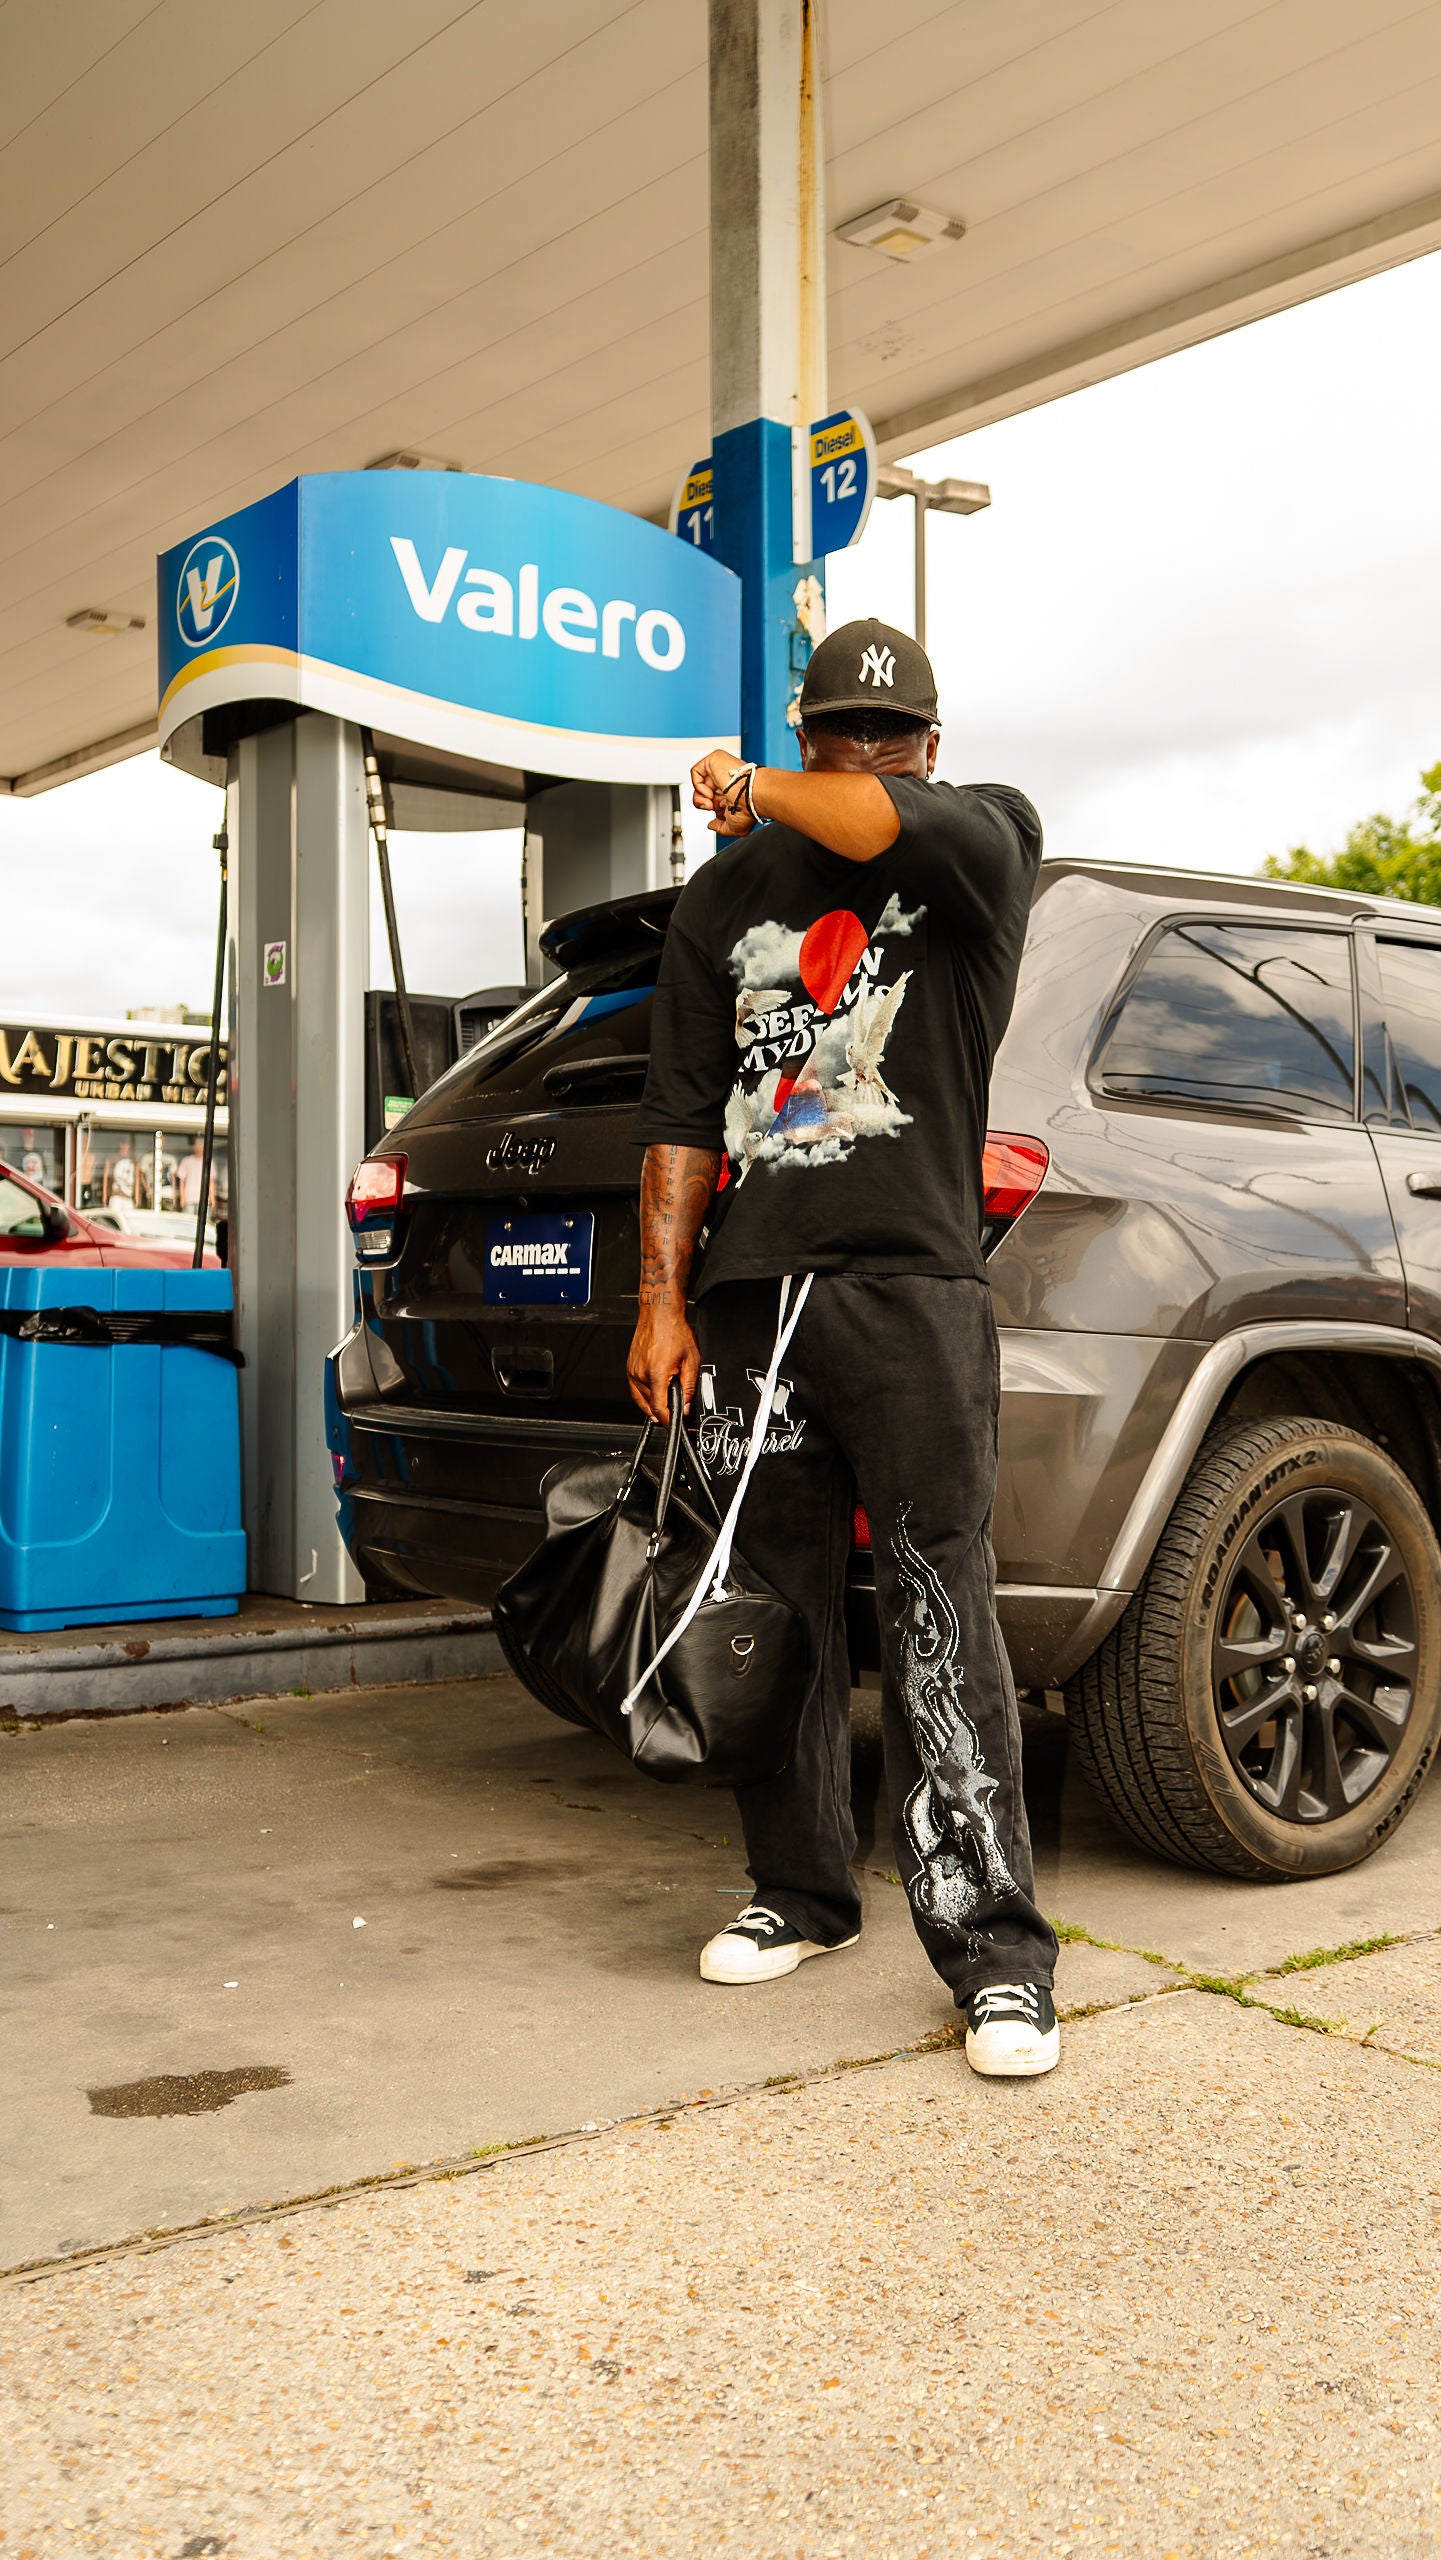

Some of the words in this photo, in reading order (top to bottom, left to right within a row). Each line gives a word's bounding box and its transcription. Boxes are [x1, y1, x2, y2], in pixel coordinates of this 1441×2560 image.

[816, 425, 856, 459] Diesel
[820, 459, 857, 503] 12
[390, 536, 687, 673] Valero
[858, 643, 897, 688] NY
[486, 1131, 557, 1175] Jeep
[1202, 1484, 1262, 1609] ROADIAN
